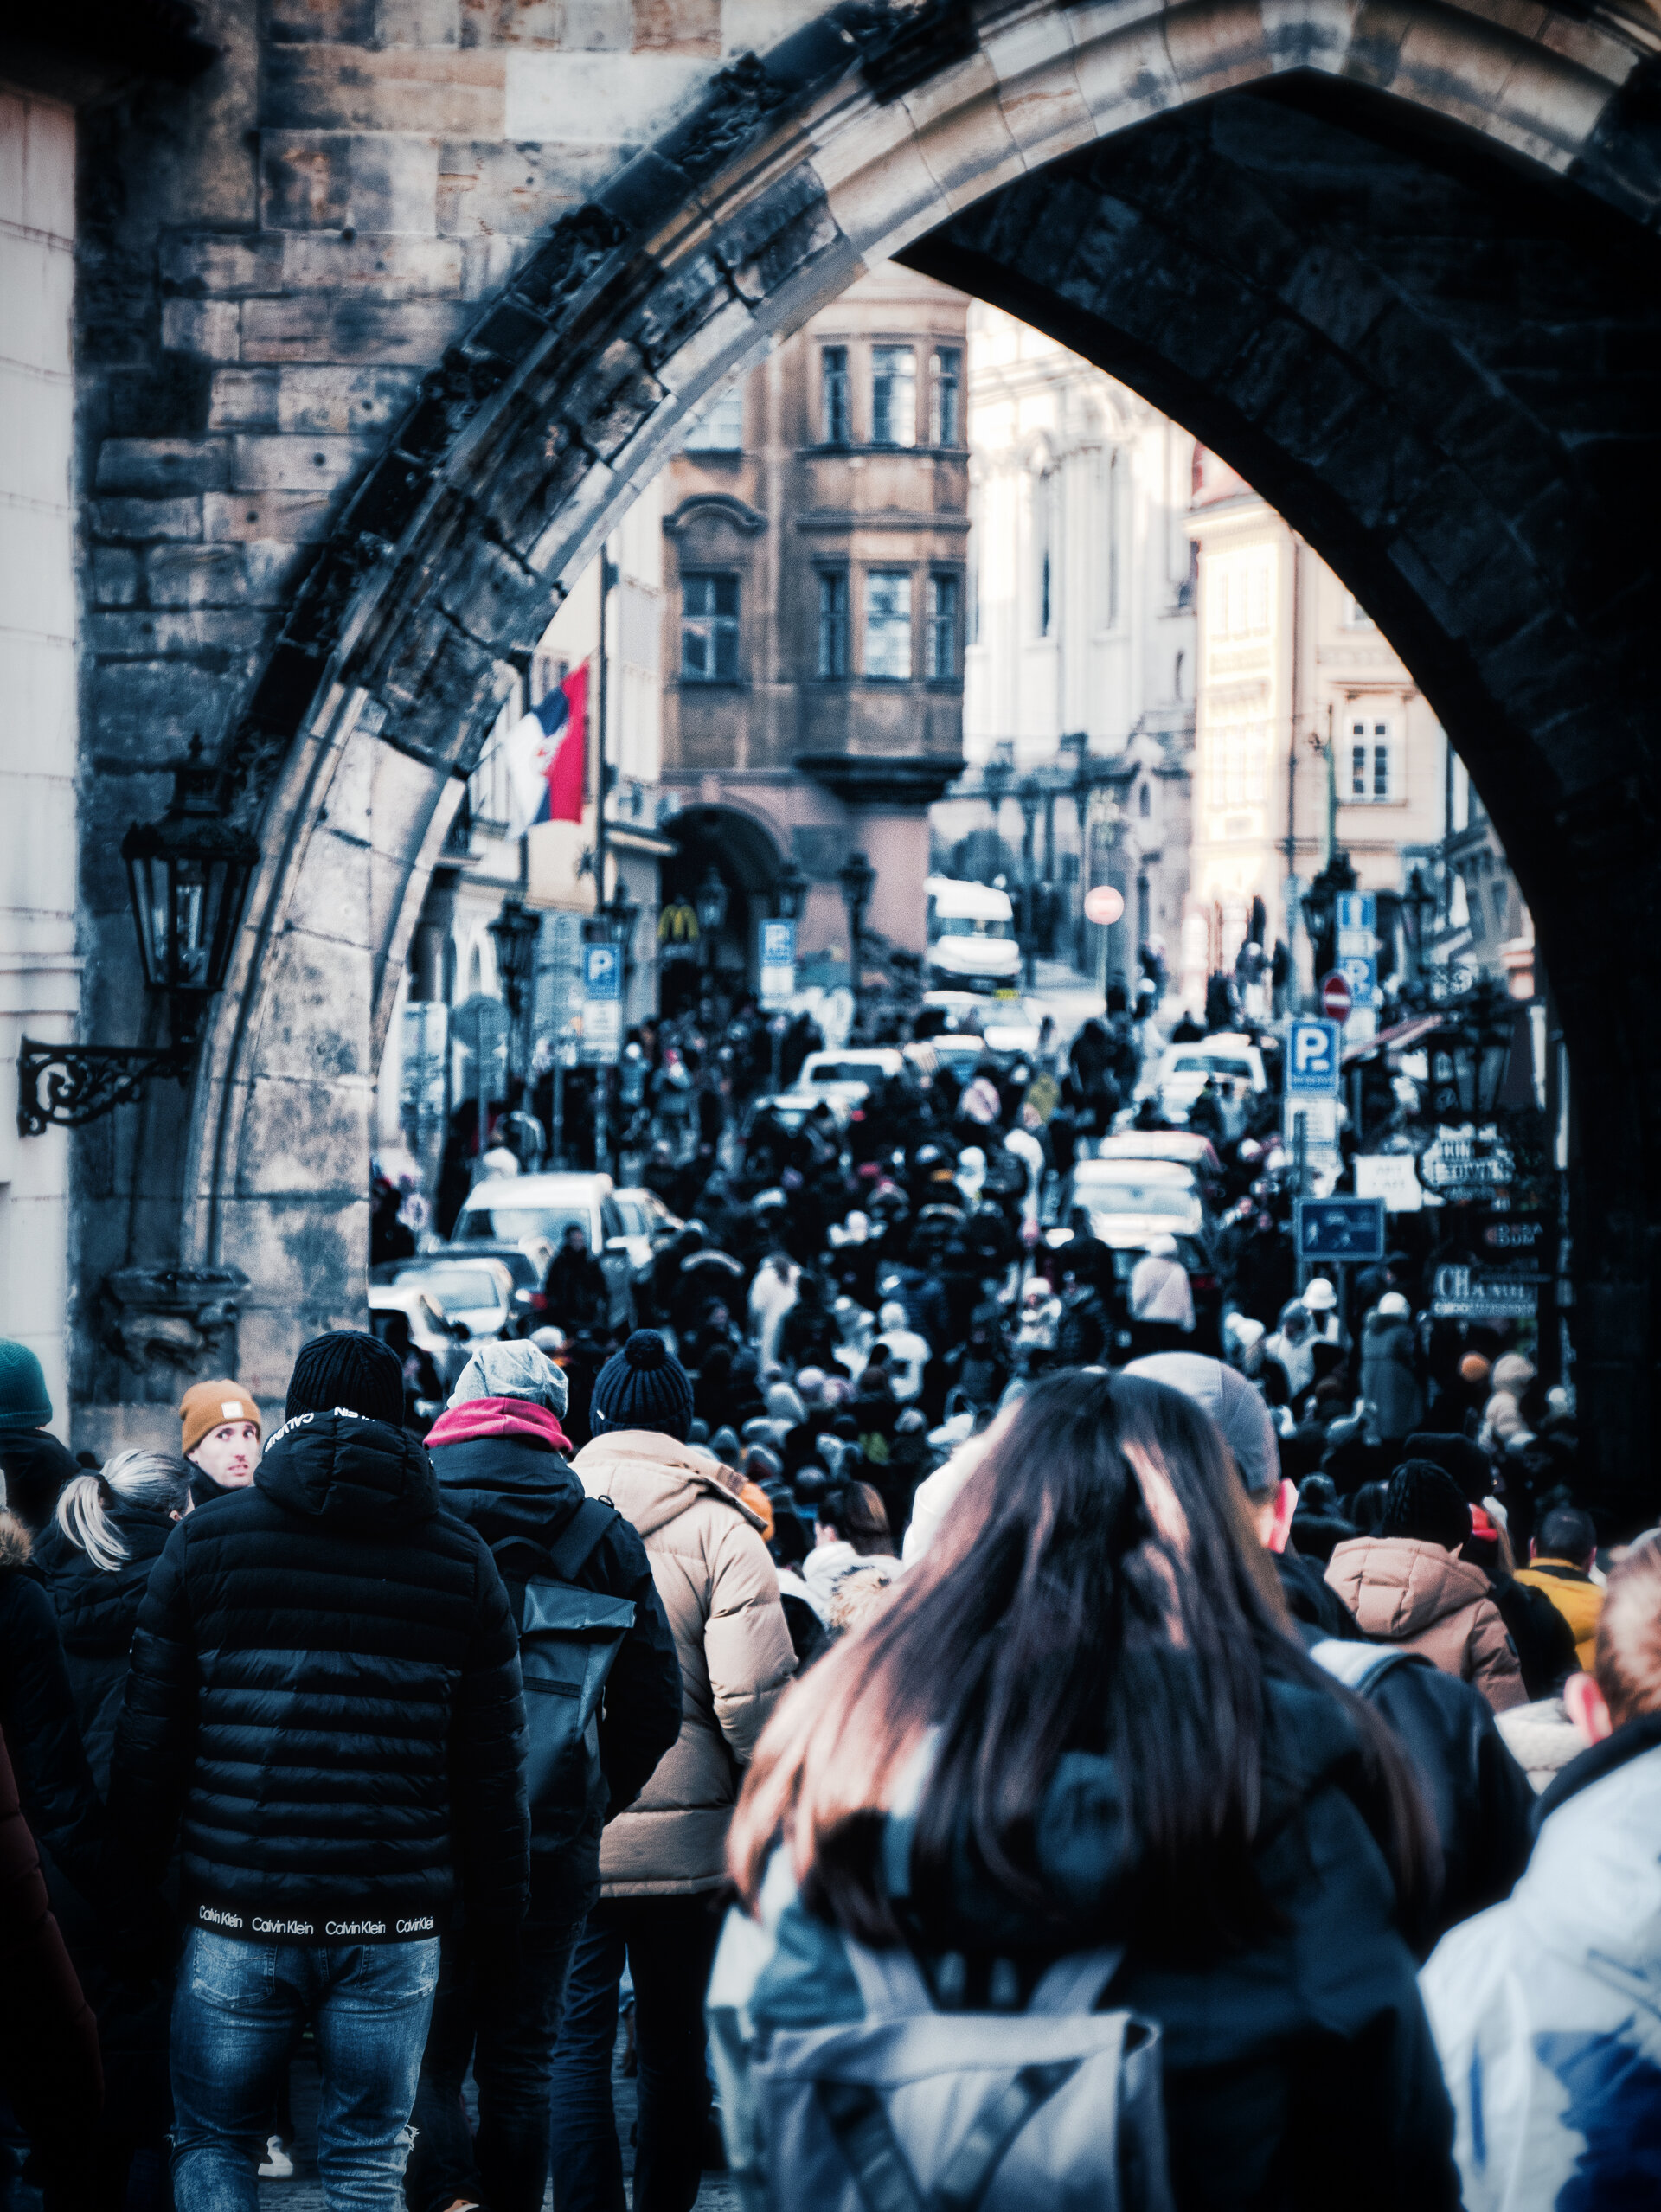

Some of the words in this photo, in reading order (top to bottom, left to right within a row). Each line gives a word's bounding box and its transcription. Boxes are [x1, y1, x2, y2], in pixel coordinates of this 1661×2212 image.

[588, 950, 613, 980] P
[1345, 959, 1369, 989] P
[1296, 1029, 1328, 1072] P
[199, 1905, 220, 1924] Calvin
[221, 1912, 243, 1928] Klein
[252, 1917, 286, 1933] Calvin
[287, 1920, 314, 1935] Klein
[325, 1920, 361, 1935] Calvin
[362, 1920, 386, 1935] Klein
[420, 1916, 434, 1930] Klei
